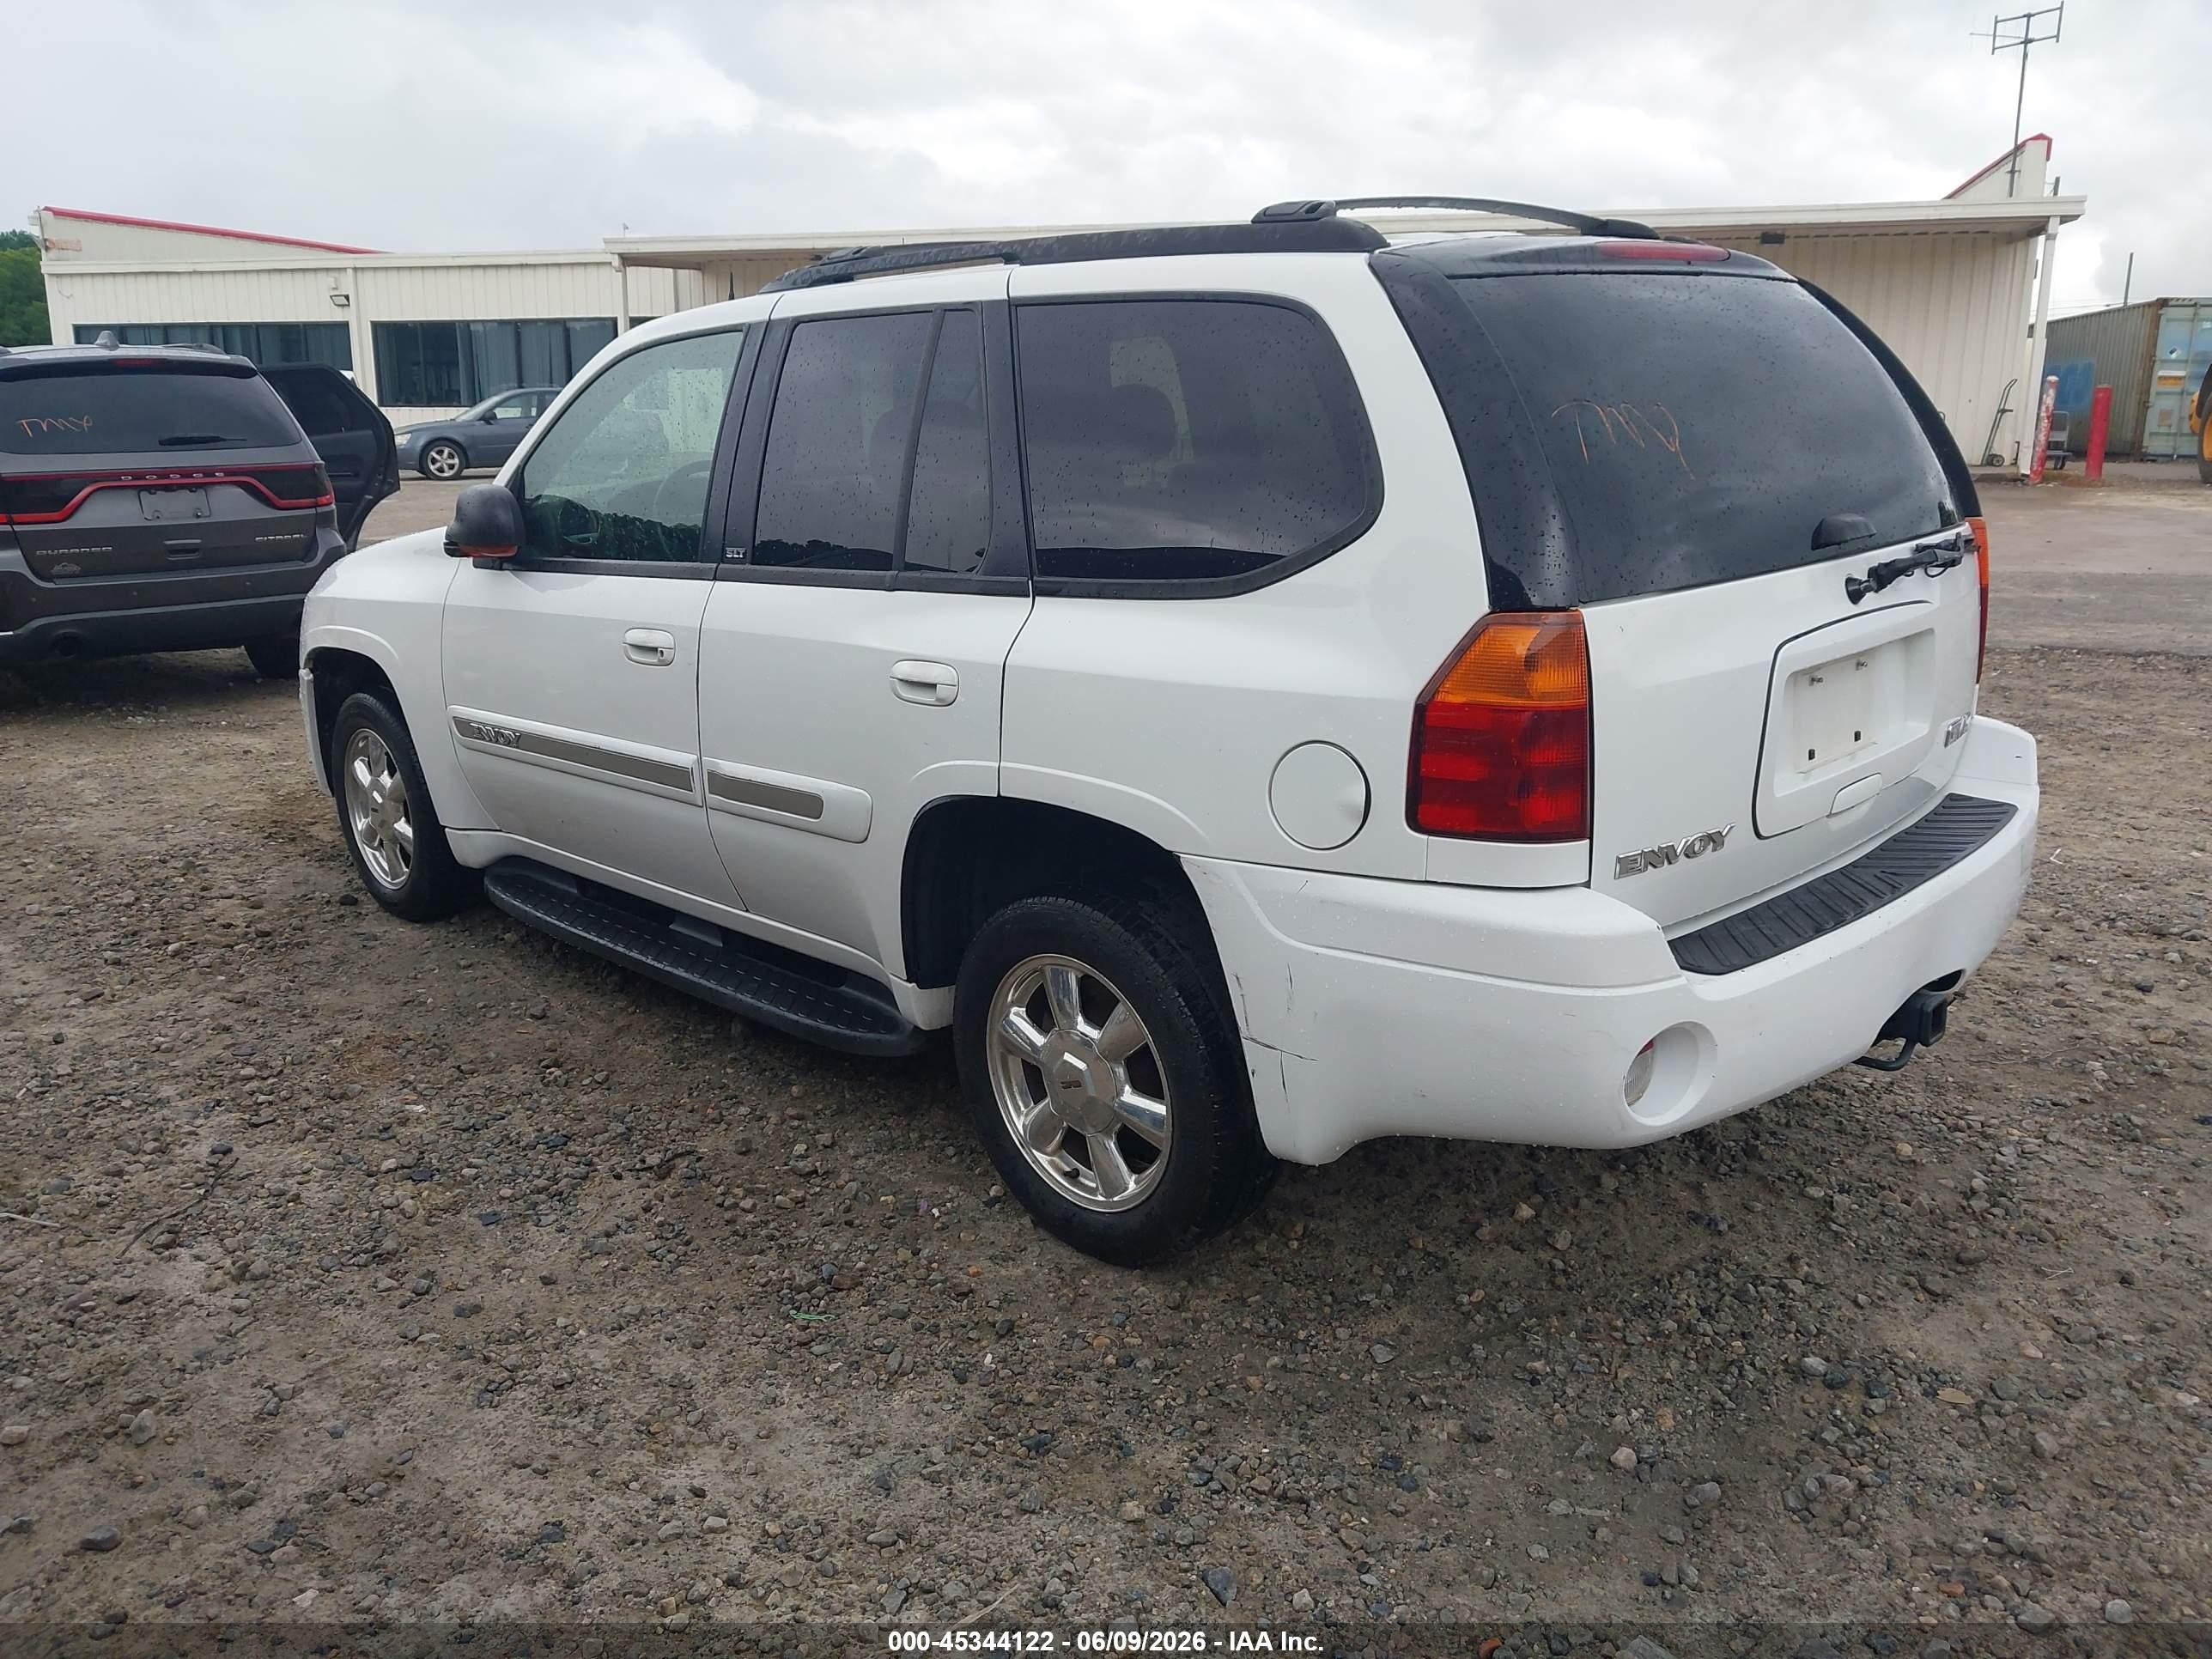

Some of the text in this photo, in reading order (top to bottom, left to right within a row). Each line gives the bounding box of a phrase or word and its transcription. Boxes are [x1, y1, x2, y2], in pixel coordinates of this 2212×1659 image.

[120, 471, 225, 481] DODGE
[726, 547, 745, 558] SLT
[469, 722, 521, 748] ENVOY
[1613, 822, 1736, 879] ENVOY
